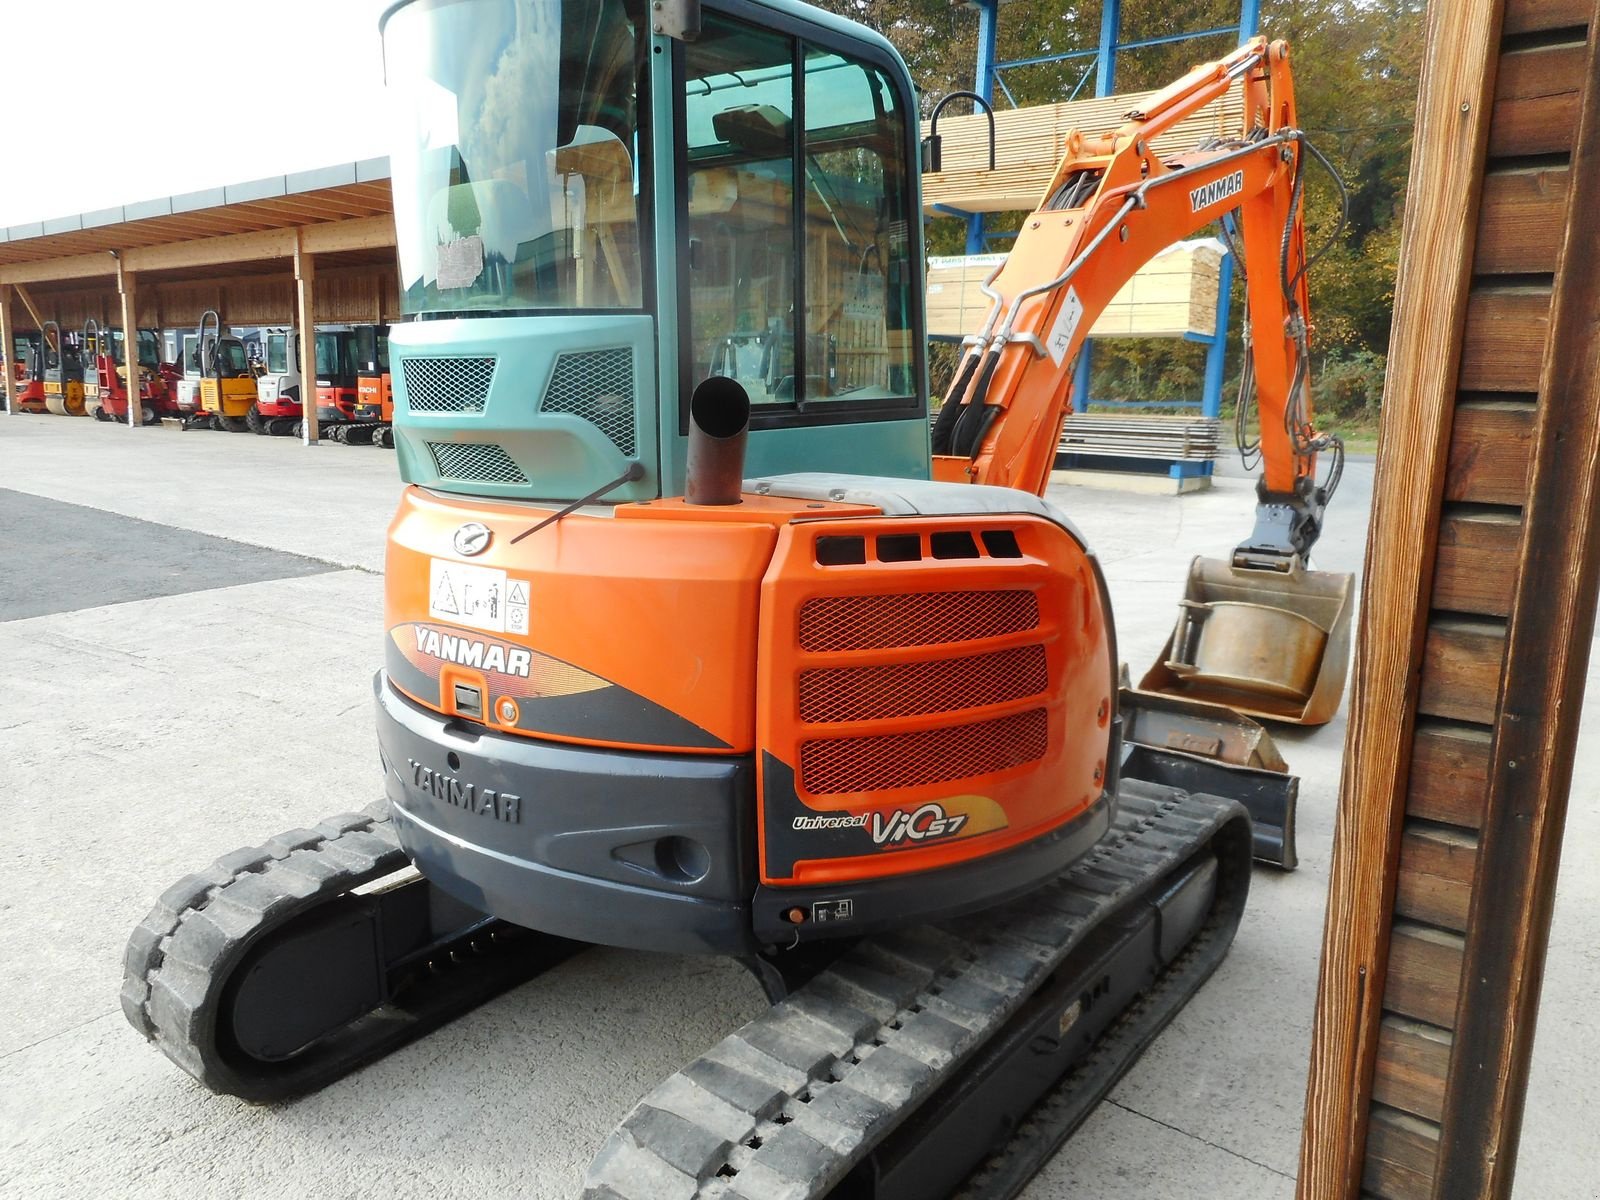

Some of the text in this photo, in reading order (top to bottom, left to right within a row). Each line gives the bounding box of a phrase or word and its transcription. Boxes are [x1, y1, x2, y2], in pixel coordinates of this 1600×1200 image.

[1190, 170, 1243, 213] YANMAR
[414, 625, 531, 678] YANMAR
[408, 758, 521, 824] YANMAR
[792, 812, 869, 829] Universal
